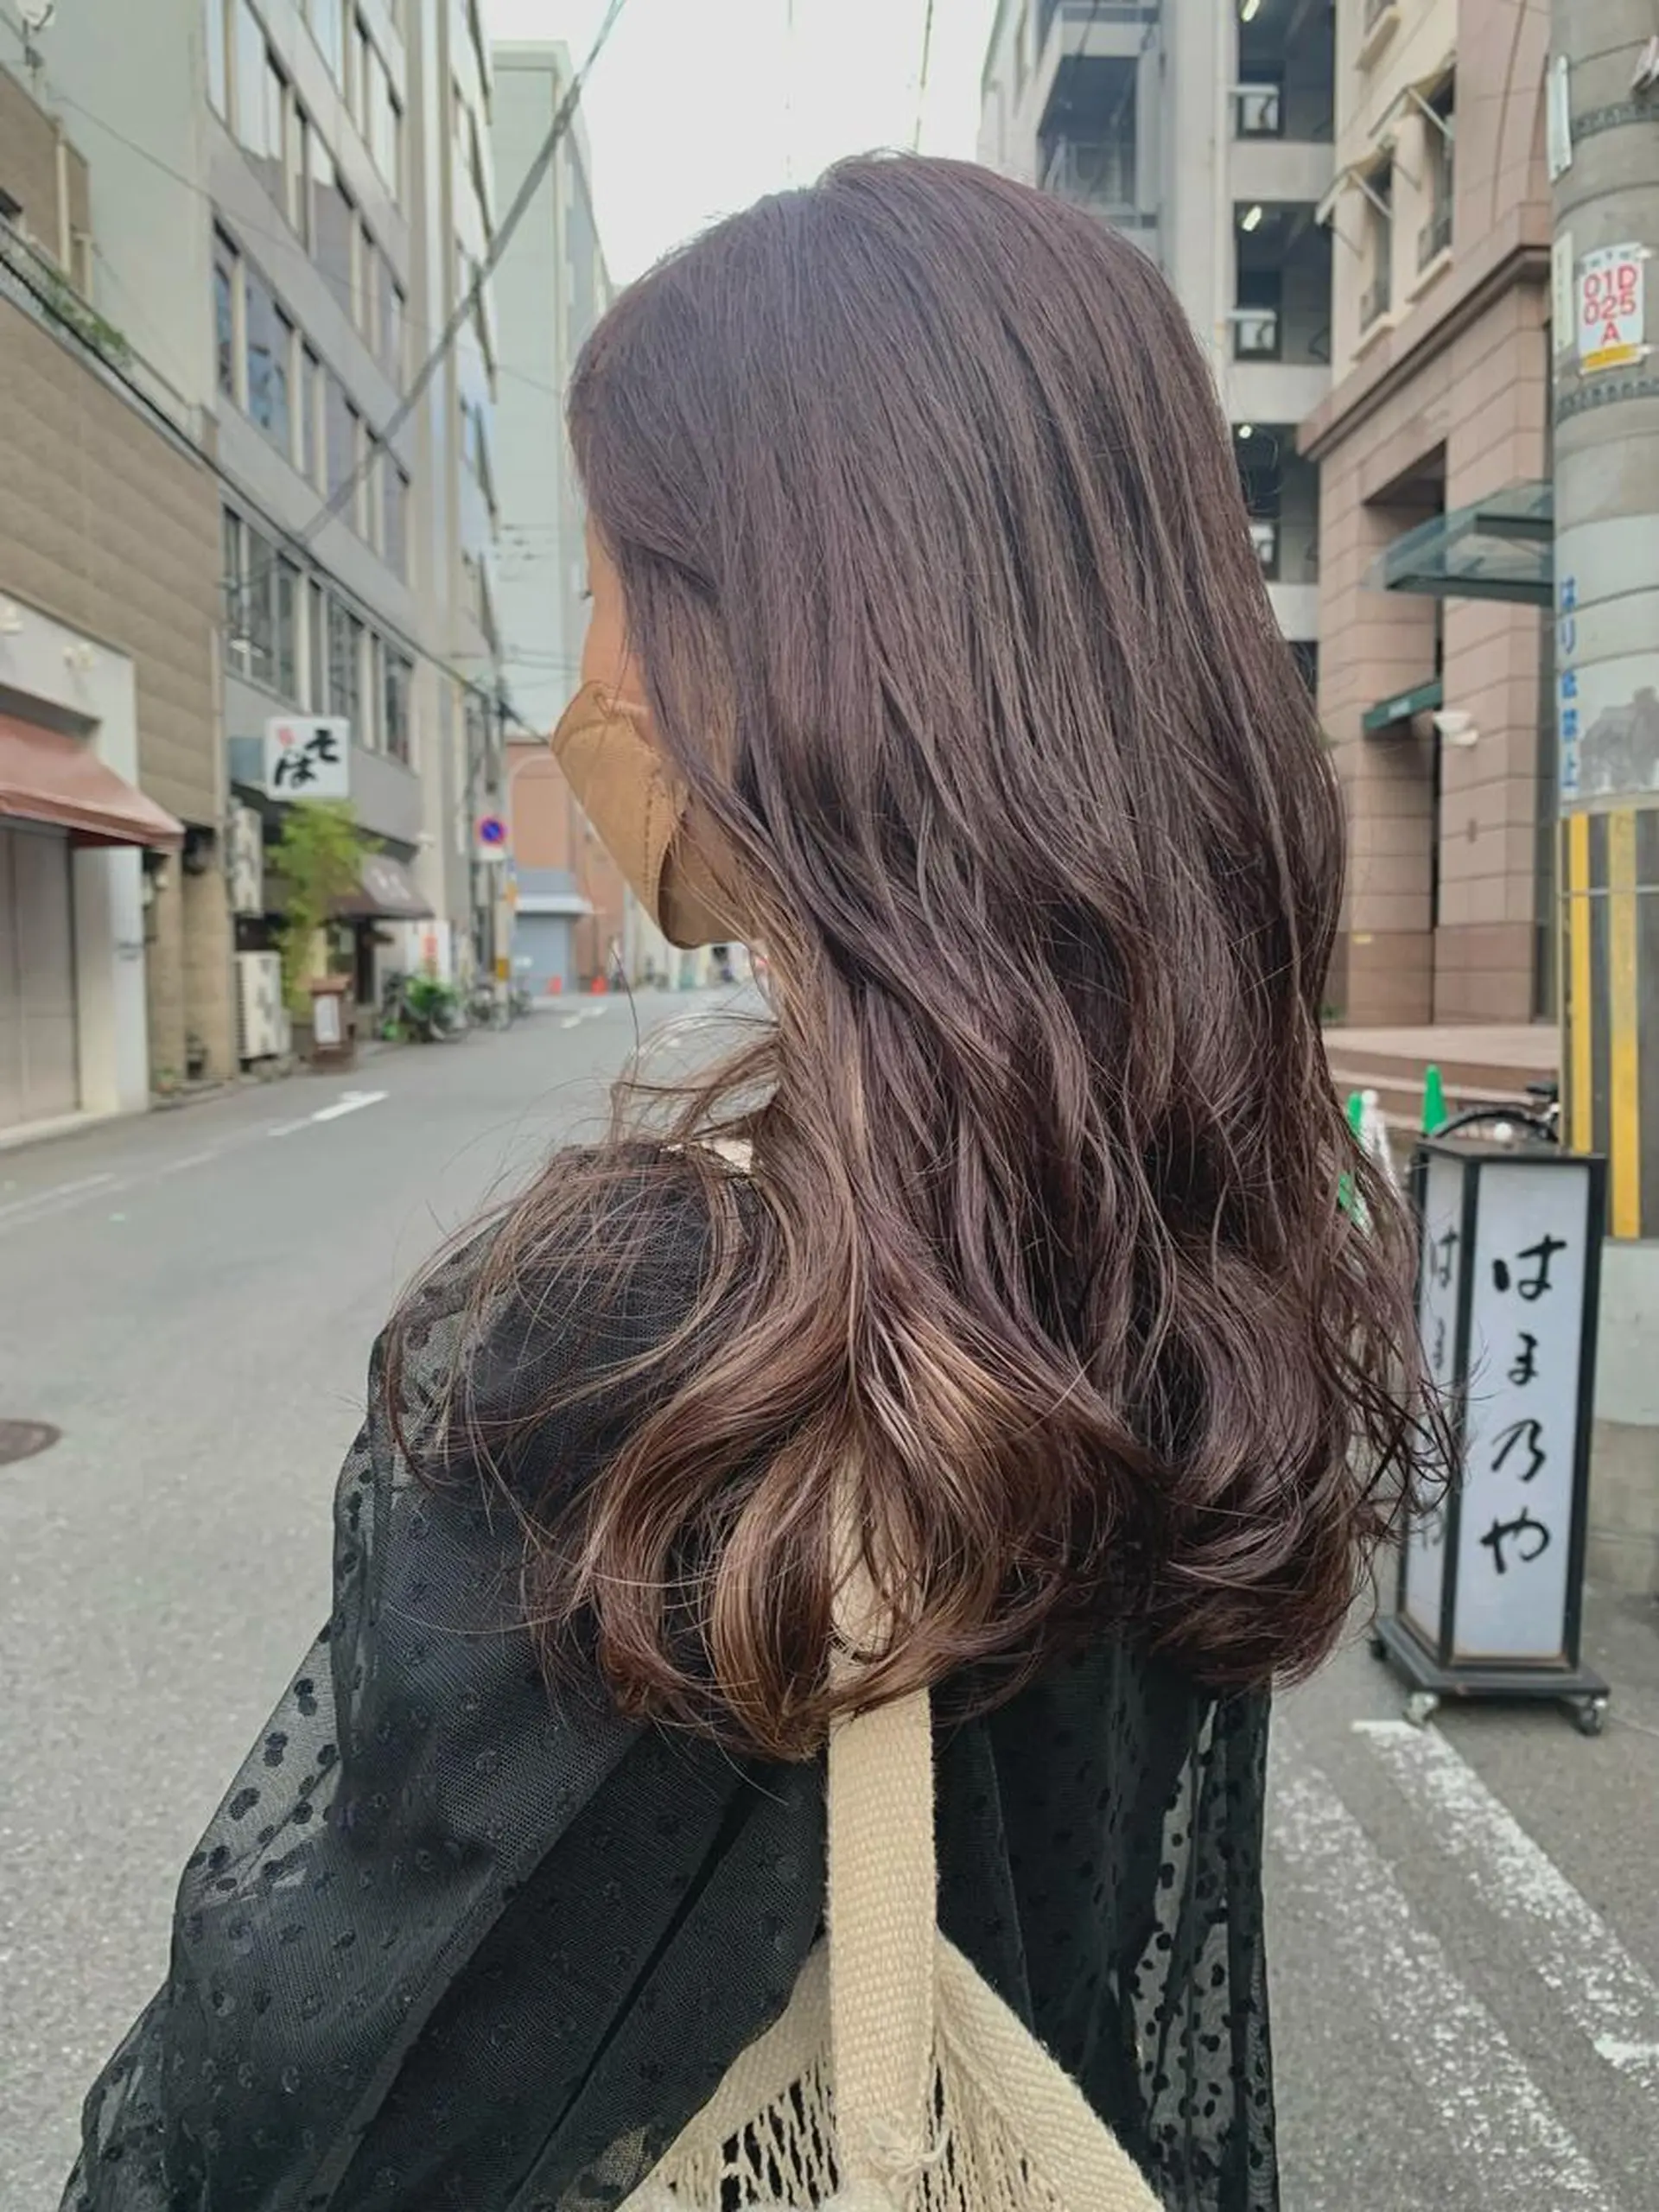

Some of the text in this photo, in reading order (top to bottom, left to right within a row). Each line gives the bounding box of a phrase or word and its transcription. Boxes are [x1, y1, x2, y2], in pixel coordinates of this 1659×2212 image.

[1584, 264, 1637, 299] 01D
[1584, 289, 1636, 326] 025
[1602, 321, 1621, 345] A
[1481, 1234, 1567, 1574] はま乃や
